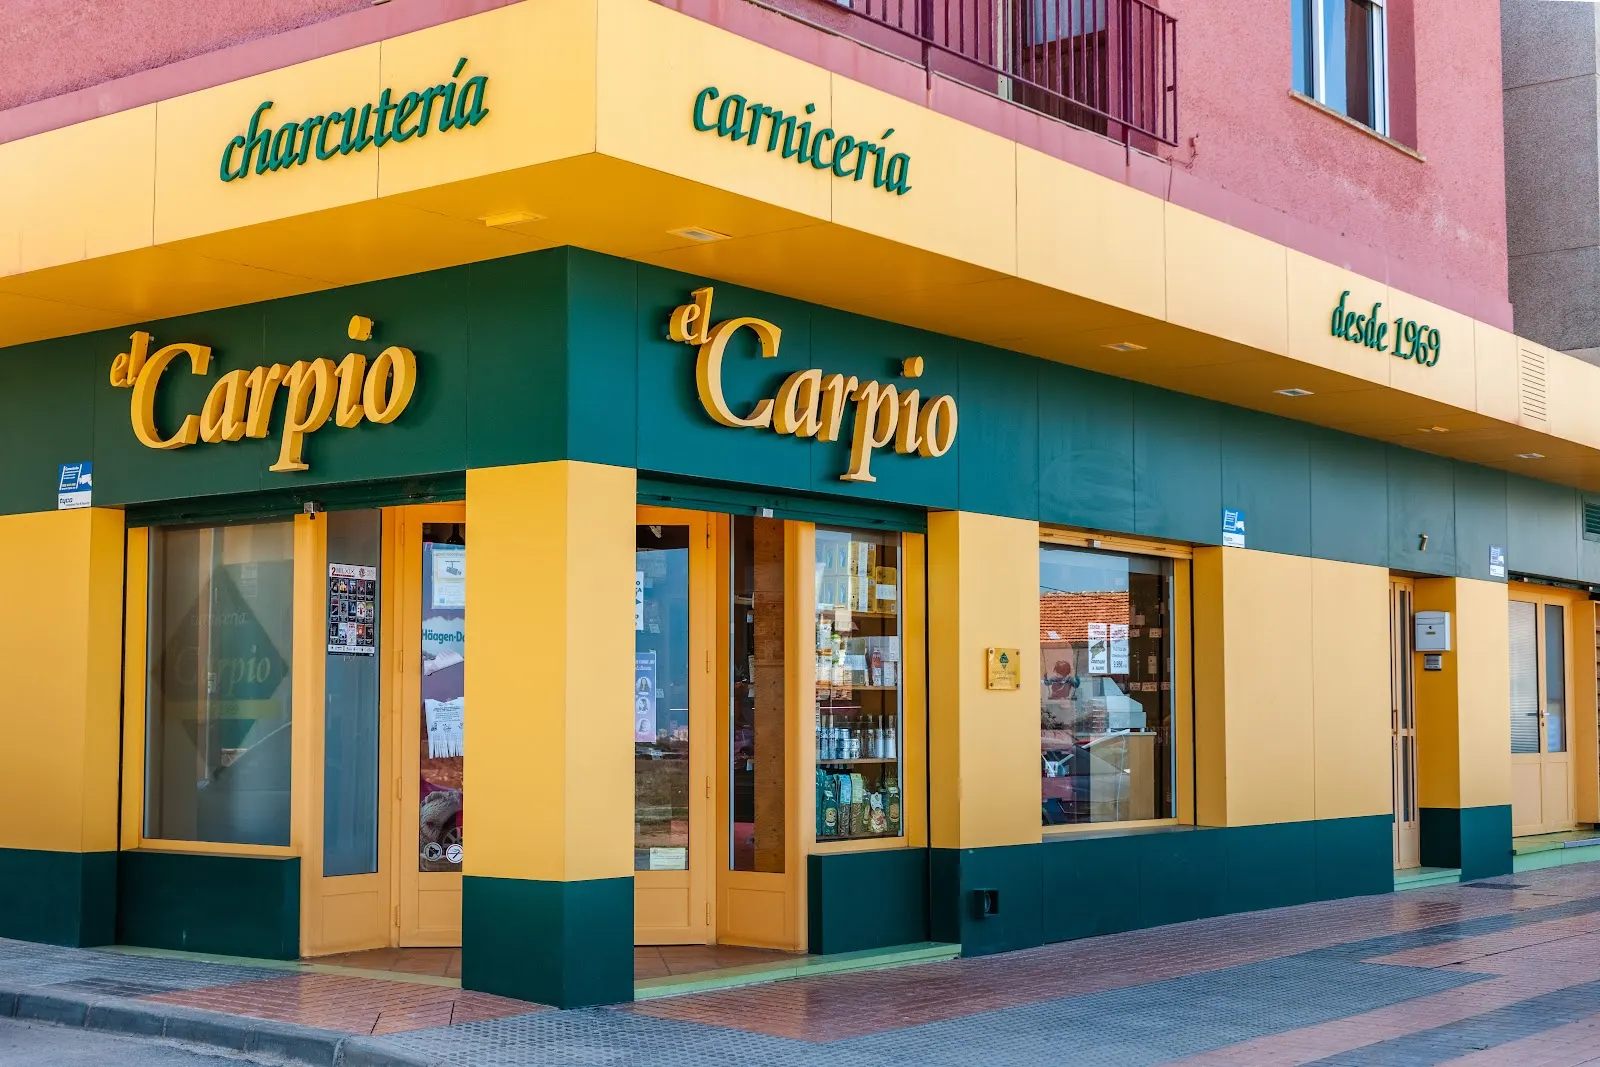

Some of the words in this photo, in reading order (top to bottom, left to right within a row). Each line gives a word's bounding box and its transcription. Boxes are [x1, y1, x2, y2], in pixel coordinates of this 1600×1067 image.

[220, 57, 490, 183] charcutería
[692, 86, 913, 196] carnicería
[667, 286, 714, 346] el
[695, 316, 958, 482] Carpio
[1330, 290, 1389, 352] desde
[1391, 317, 1441, 367] 1969
[110, 330, 150, 388] el
[130, 314, 417, 472] Carpio
[422, 629, 465, 644] Häagen-D
